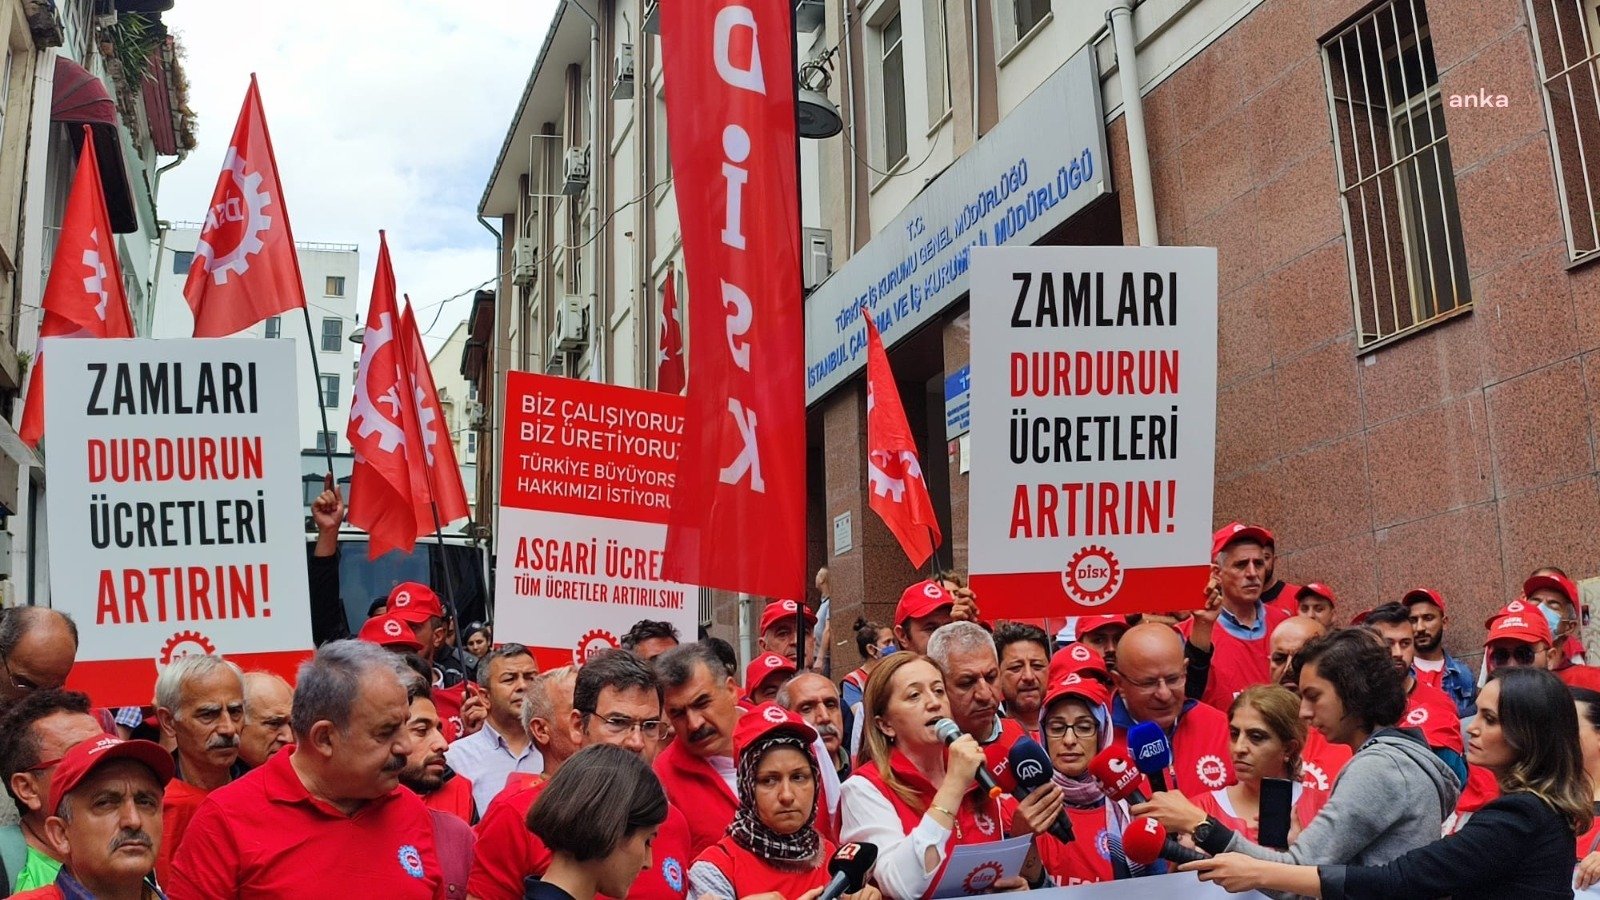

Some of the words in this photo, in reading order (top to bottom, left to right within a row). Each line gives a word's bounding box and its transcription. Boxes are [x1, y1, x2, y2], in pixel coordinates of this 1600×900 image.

[868, 285, 878, 310] İŞ
[878, 254, 918, 300] KURUMU
[919, 226, 953, 265] GENEL
[954, 158, 1028, 240] MÜDÜRLÜĞÜ
[906, 216, 926, 241] T.C.
[807, 342, 849, 389] İSTANBUL
[849, 307, 894, 361] ÇALMA
[893, 293, 909, 322] VE
[910, 283, 922, 312] İŞ
[924, 241, 976, 301] KURUM
[994, 147, 1094, 246] MÜDÜRLÜĞÜ
[1010, 271, 1177, 328] ZAMLARI
[86, 361, 259, 416] ZAMLARI
[1010, 350, 1179, 397] DURDURUN
[521, 391, 556, 417] BİZ
[520, 418, 555, 445] BİZ
[560, 421, 681, 461] ÜRETİYORU
[1009, 405, 1178, 464] ÜCRETLERİ
[87, 436, 264, 483] DURDURUN
[519, 451, 590, 478] TÜRKİYE
[594, 461, 676, 488] BÜYÜYORS
[517, 477, 603, 501] HAKKIMIZI
[606, 482, 671, 509] İSTİYOR
[1009, 480, 1176, 539] ARTIRIN!
[90, 490, 267, 549] ÜCRETLERİ
[514, 536, 597, 576] ASGARİ
[1077, 563, 1109, 580] DİSK
[96, 563, 272, 625] ARTIRIN!
[514, 575, 541, 597] TÜM
[545, 575, 608, 603] ÜCRETLER
[612, 585, 684, 610] ARTIRILSIN!
[992, 757, 1010, 776] DH
[1020, 763, 1043, 780] AA
